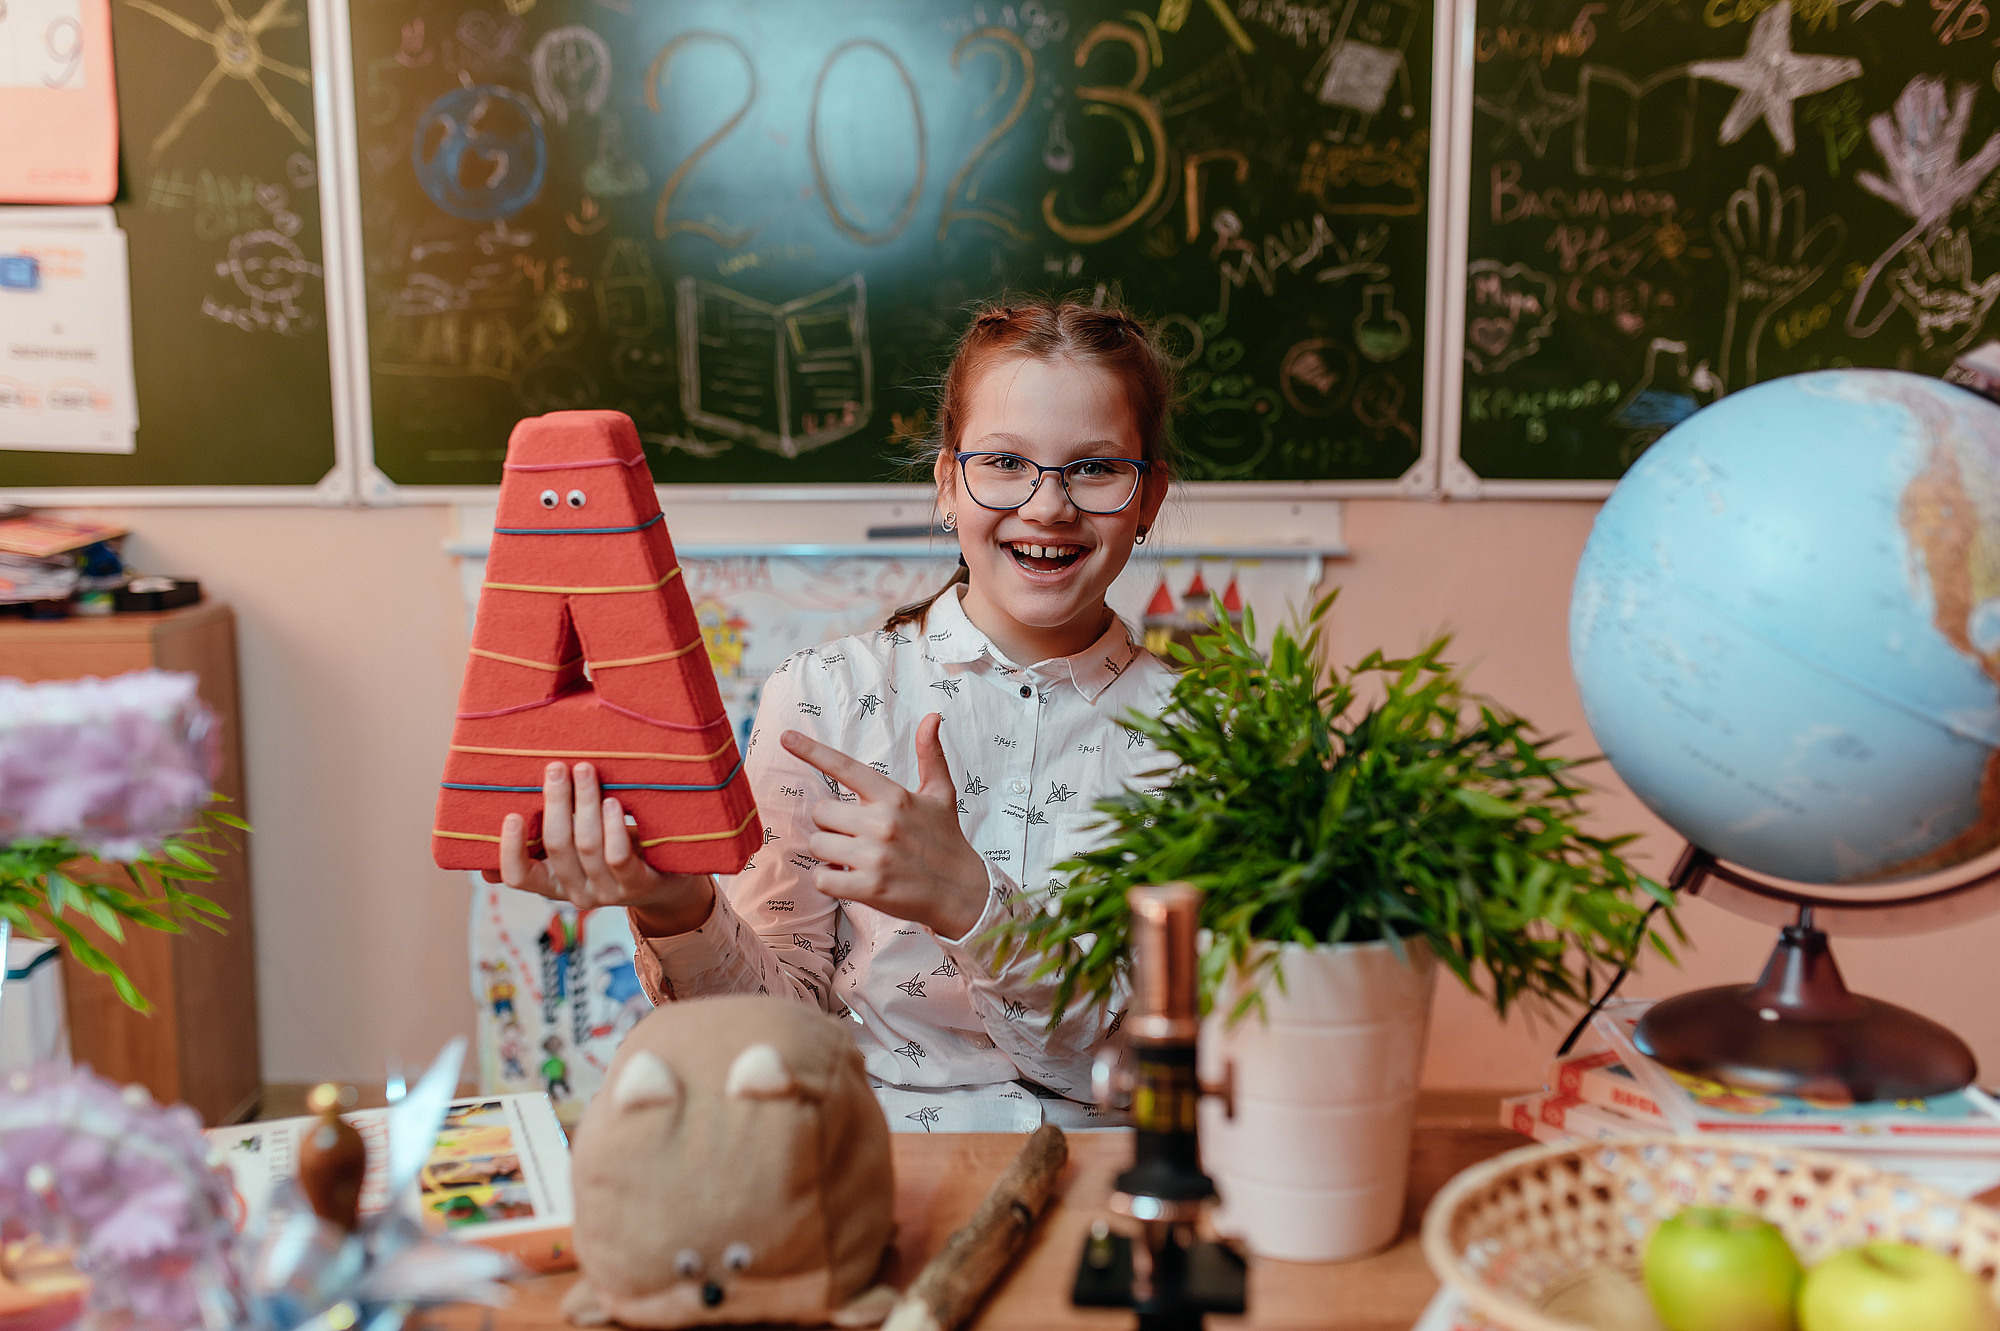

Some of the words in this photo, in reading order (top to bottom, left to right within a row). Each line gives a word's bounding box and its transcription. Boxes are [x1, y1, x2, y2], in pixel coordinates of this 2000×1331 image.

[644, 21, 1169, 246] 2023
[797, 702, 822, 711] cranes
[799, 708, 822, 717] paper
[1001, 808, 1026, 820] paper
[788, 858, 811, 871] paper
[766, 899, 795, 907] cranes
